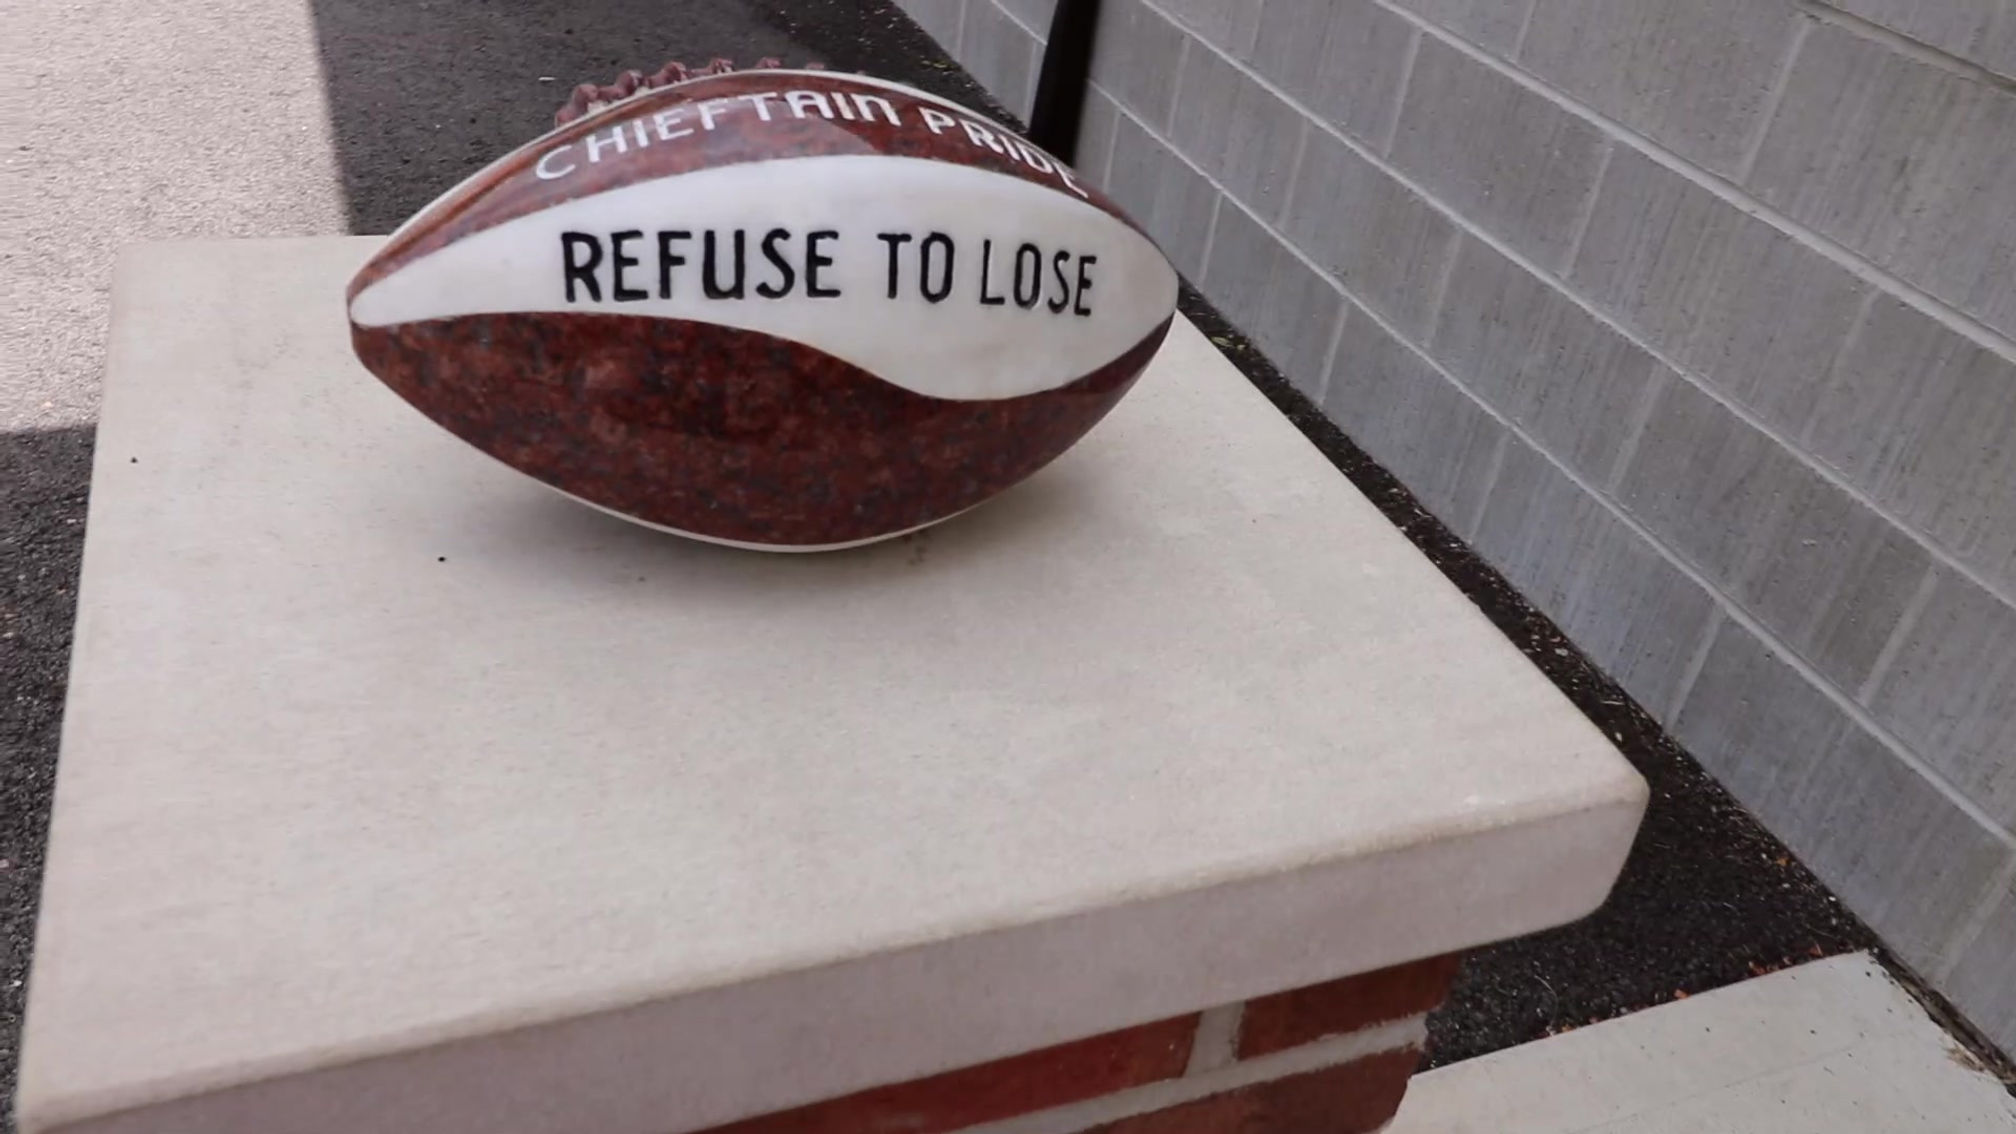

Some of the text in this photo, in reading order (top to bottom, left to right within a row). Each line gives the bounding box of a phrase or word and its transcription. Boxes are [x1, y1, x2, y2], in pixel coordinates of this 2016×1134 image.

[535, 90, 1088, 198] CHIEFTAIN PRIDE
[560, 228, 1097, 316] REFUSE TO LOSE
